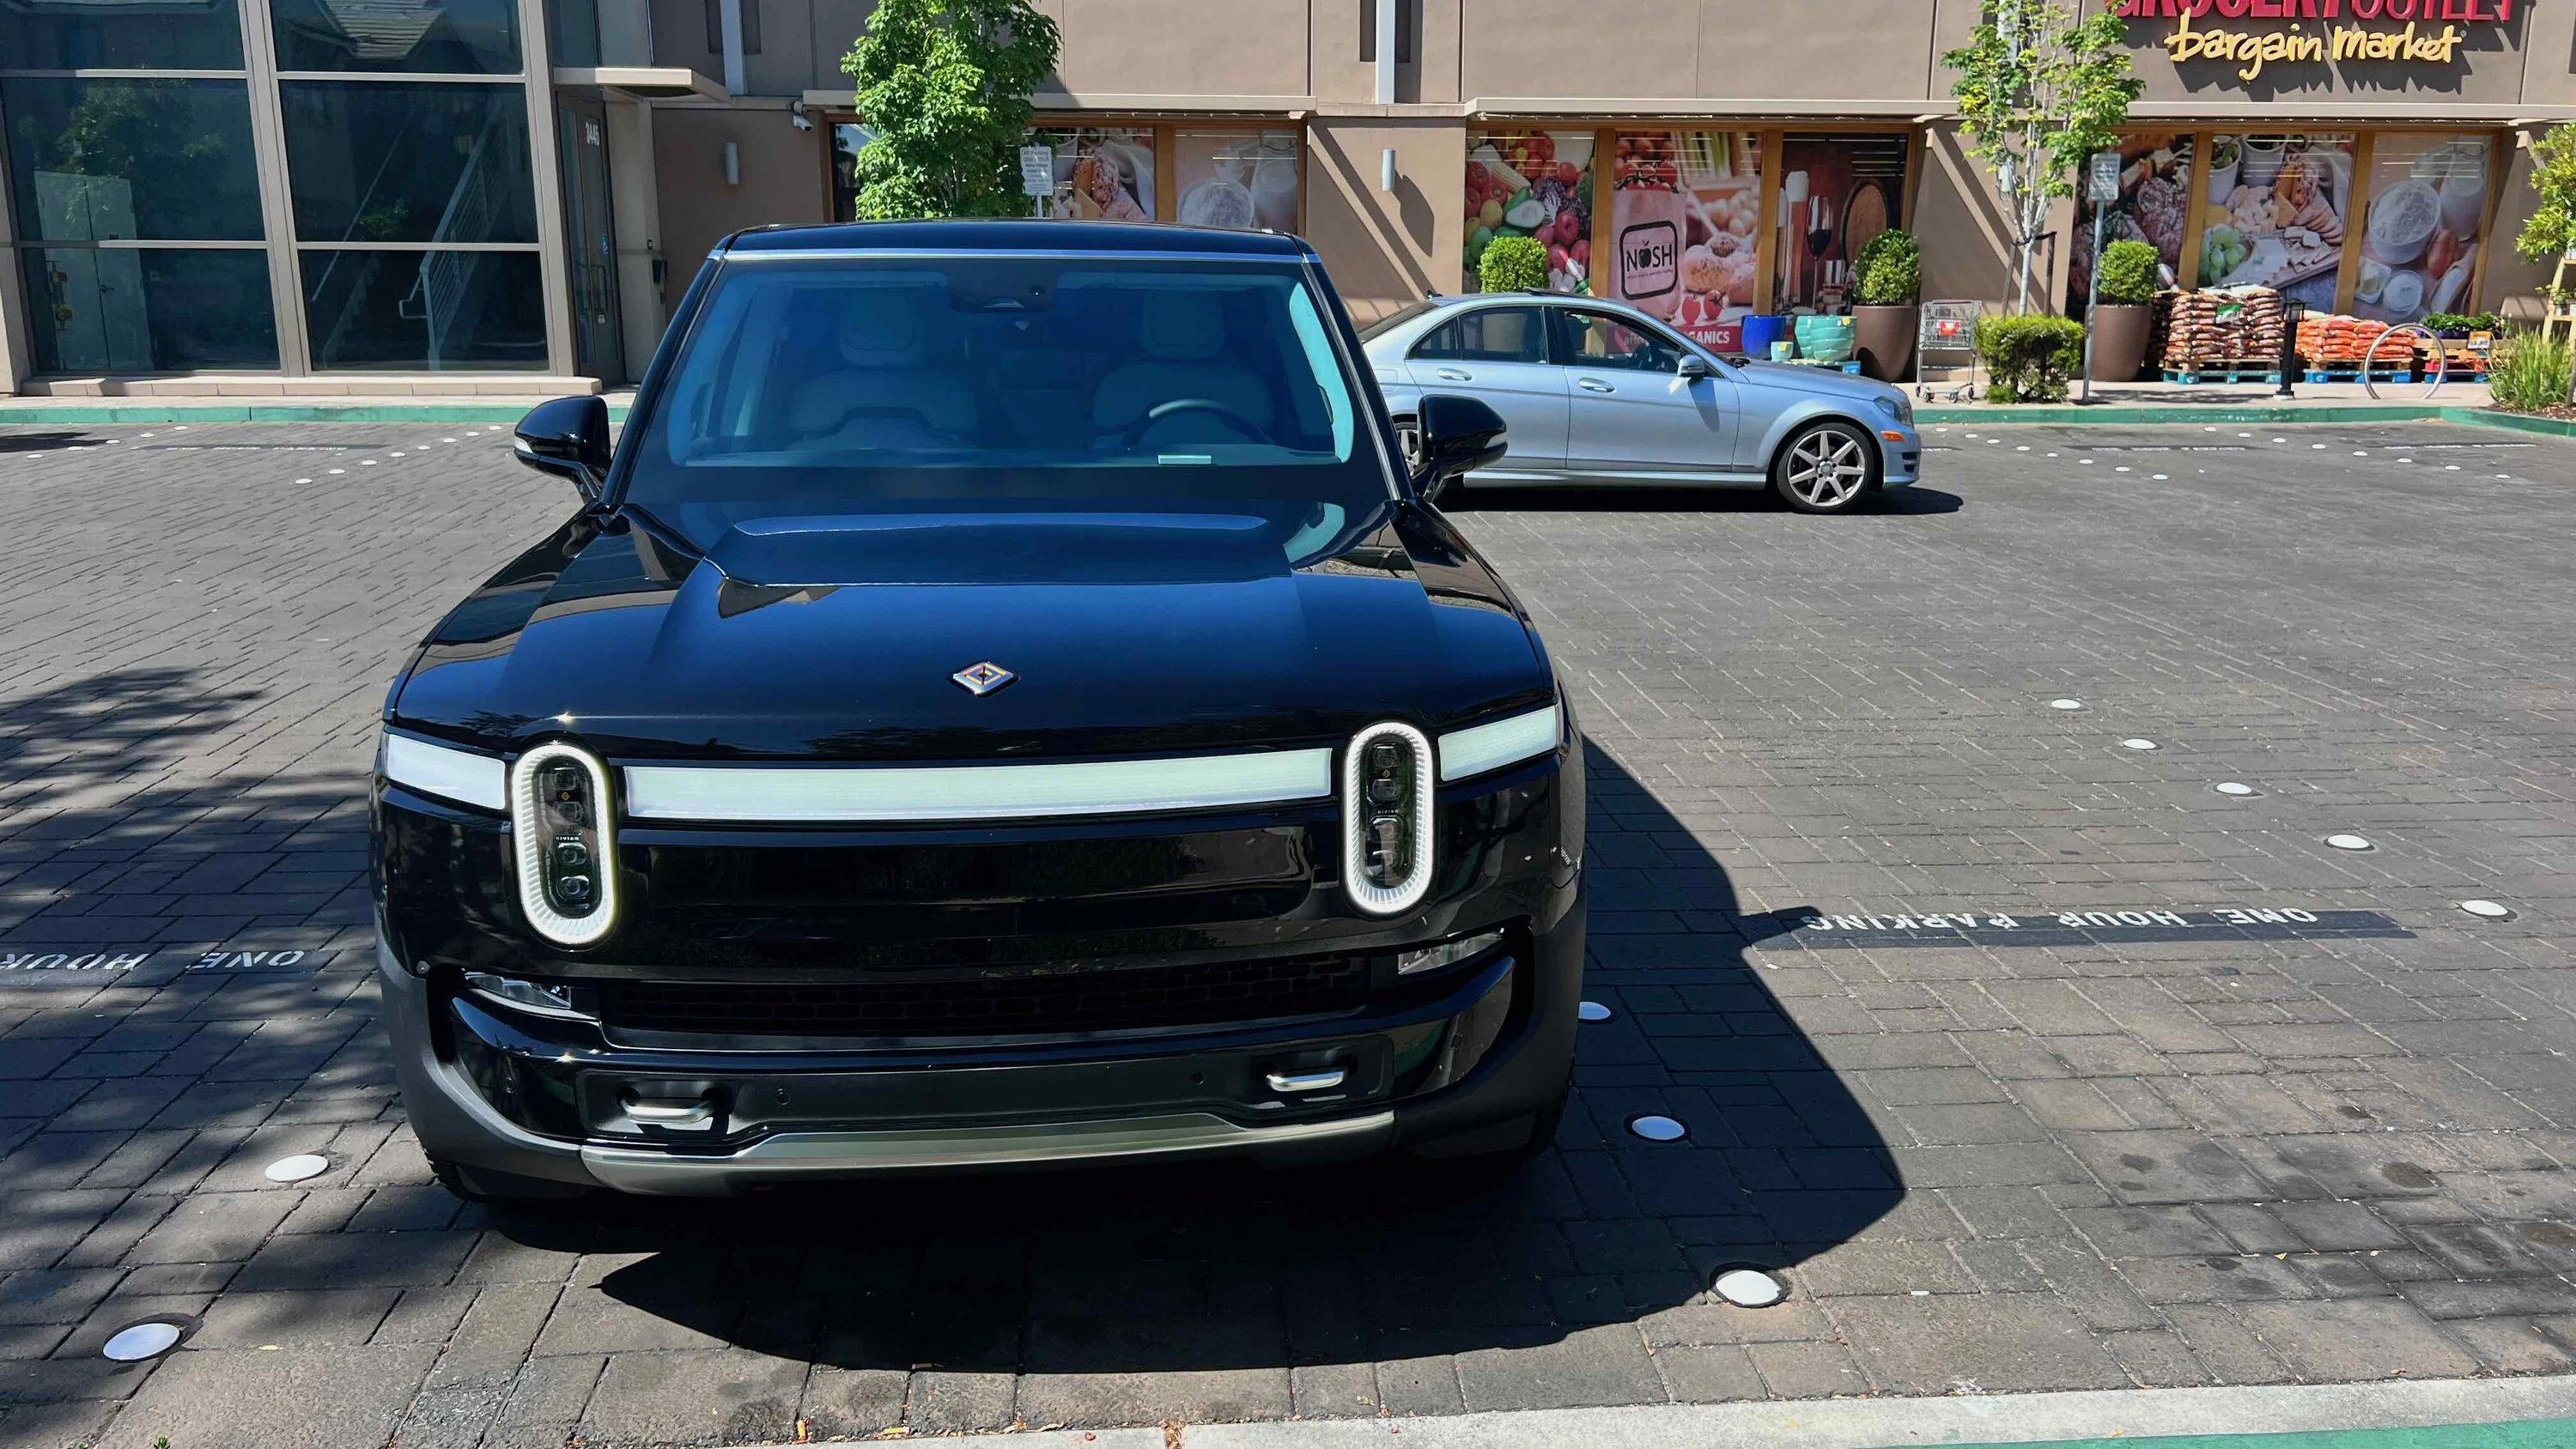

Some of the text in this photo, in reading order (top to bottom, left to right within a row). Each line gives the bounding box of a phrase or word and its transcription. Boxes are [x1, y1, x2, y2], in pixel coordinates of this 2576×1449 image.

[2164, 7, 2322, 81] bargain
[2050, 910, 2194, 928] HOUR
[2213, 907, 2318, 925] ONE
[185, 949, 305, 970] ONE
